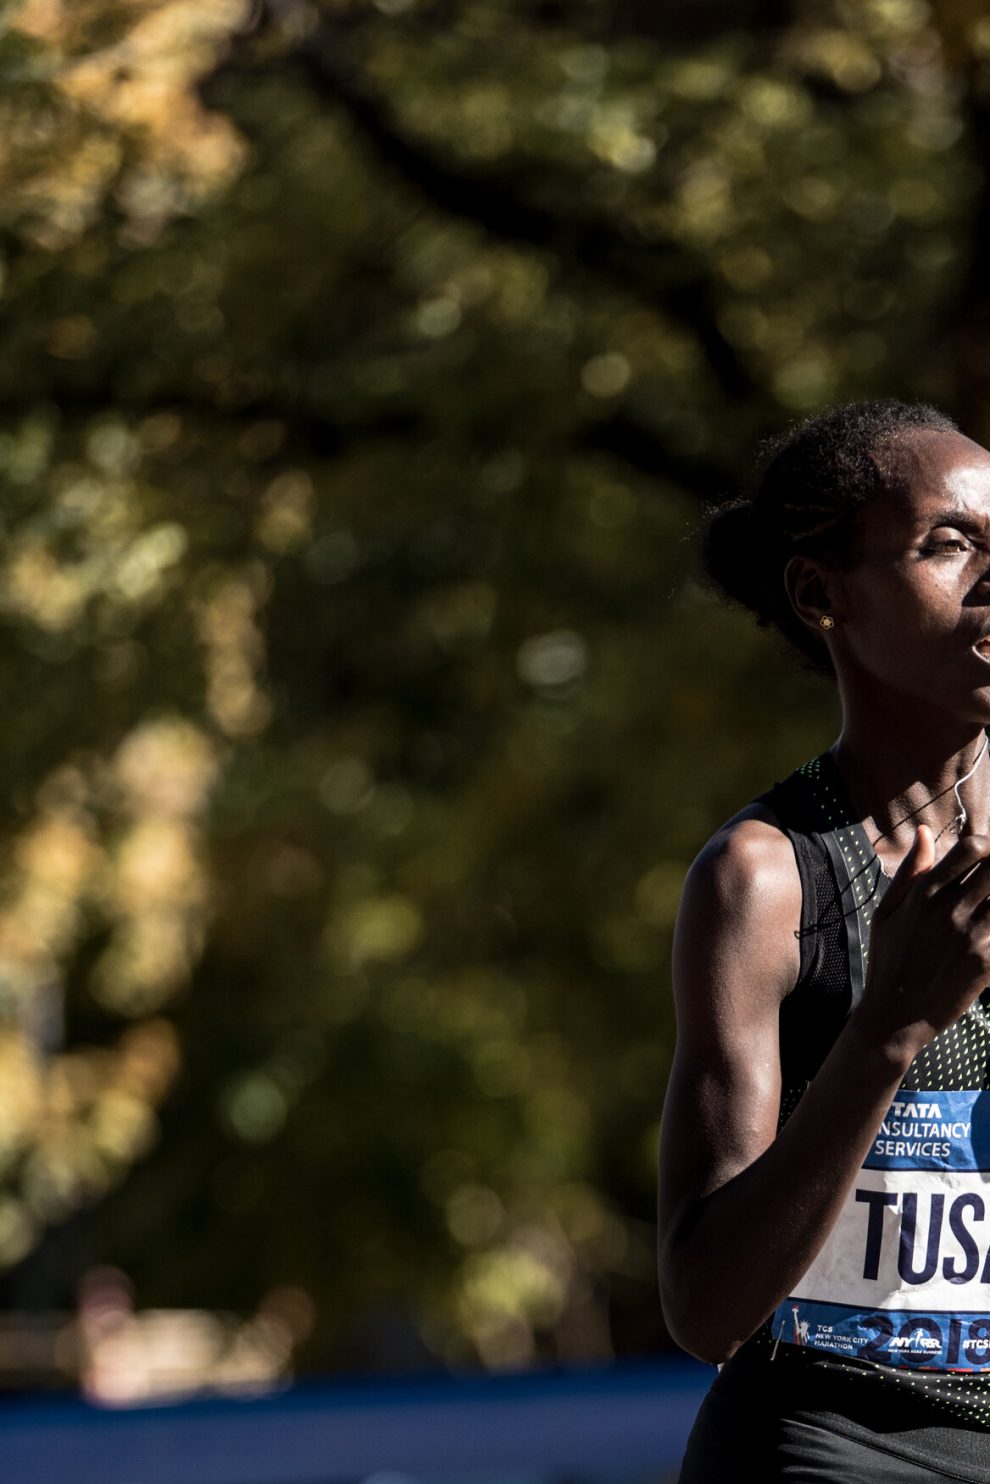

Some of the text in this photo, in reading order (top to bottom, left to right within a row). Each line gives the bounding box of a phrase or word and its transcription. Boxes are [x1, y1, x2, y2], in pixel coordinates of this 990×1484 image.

[891, 1102, 942, 1119] TATA
[878, 1121, 971, 1139] NSULTANCY
[874, 1140, 951, 1157] SERVICES
[817, 1324, 833, 1333] TCS
[832, 1334, 852, 1342] YORK
[814, 1340, 853, 1350] MARATHON
